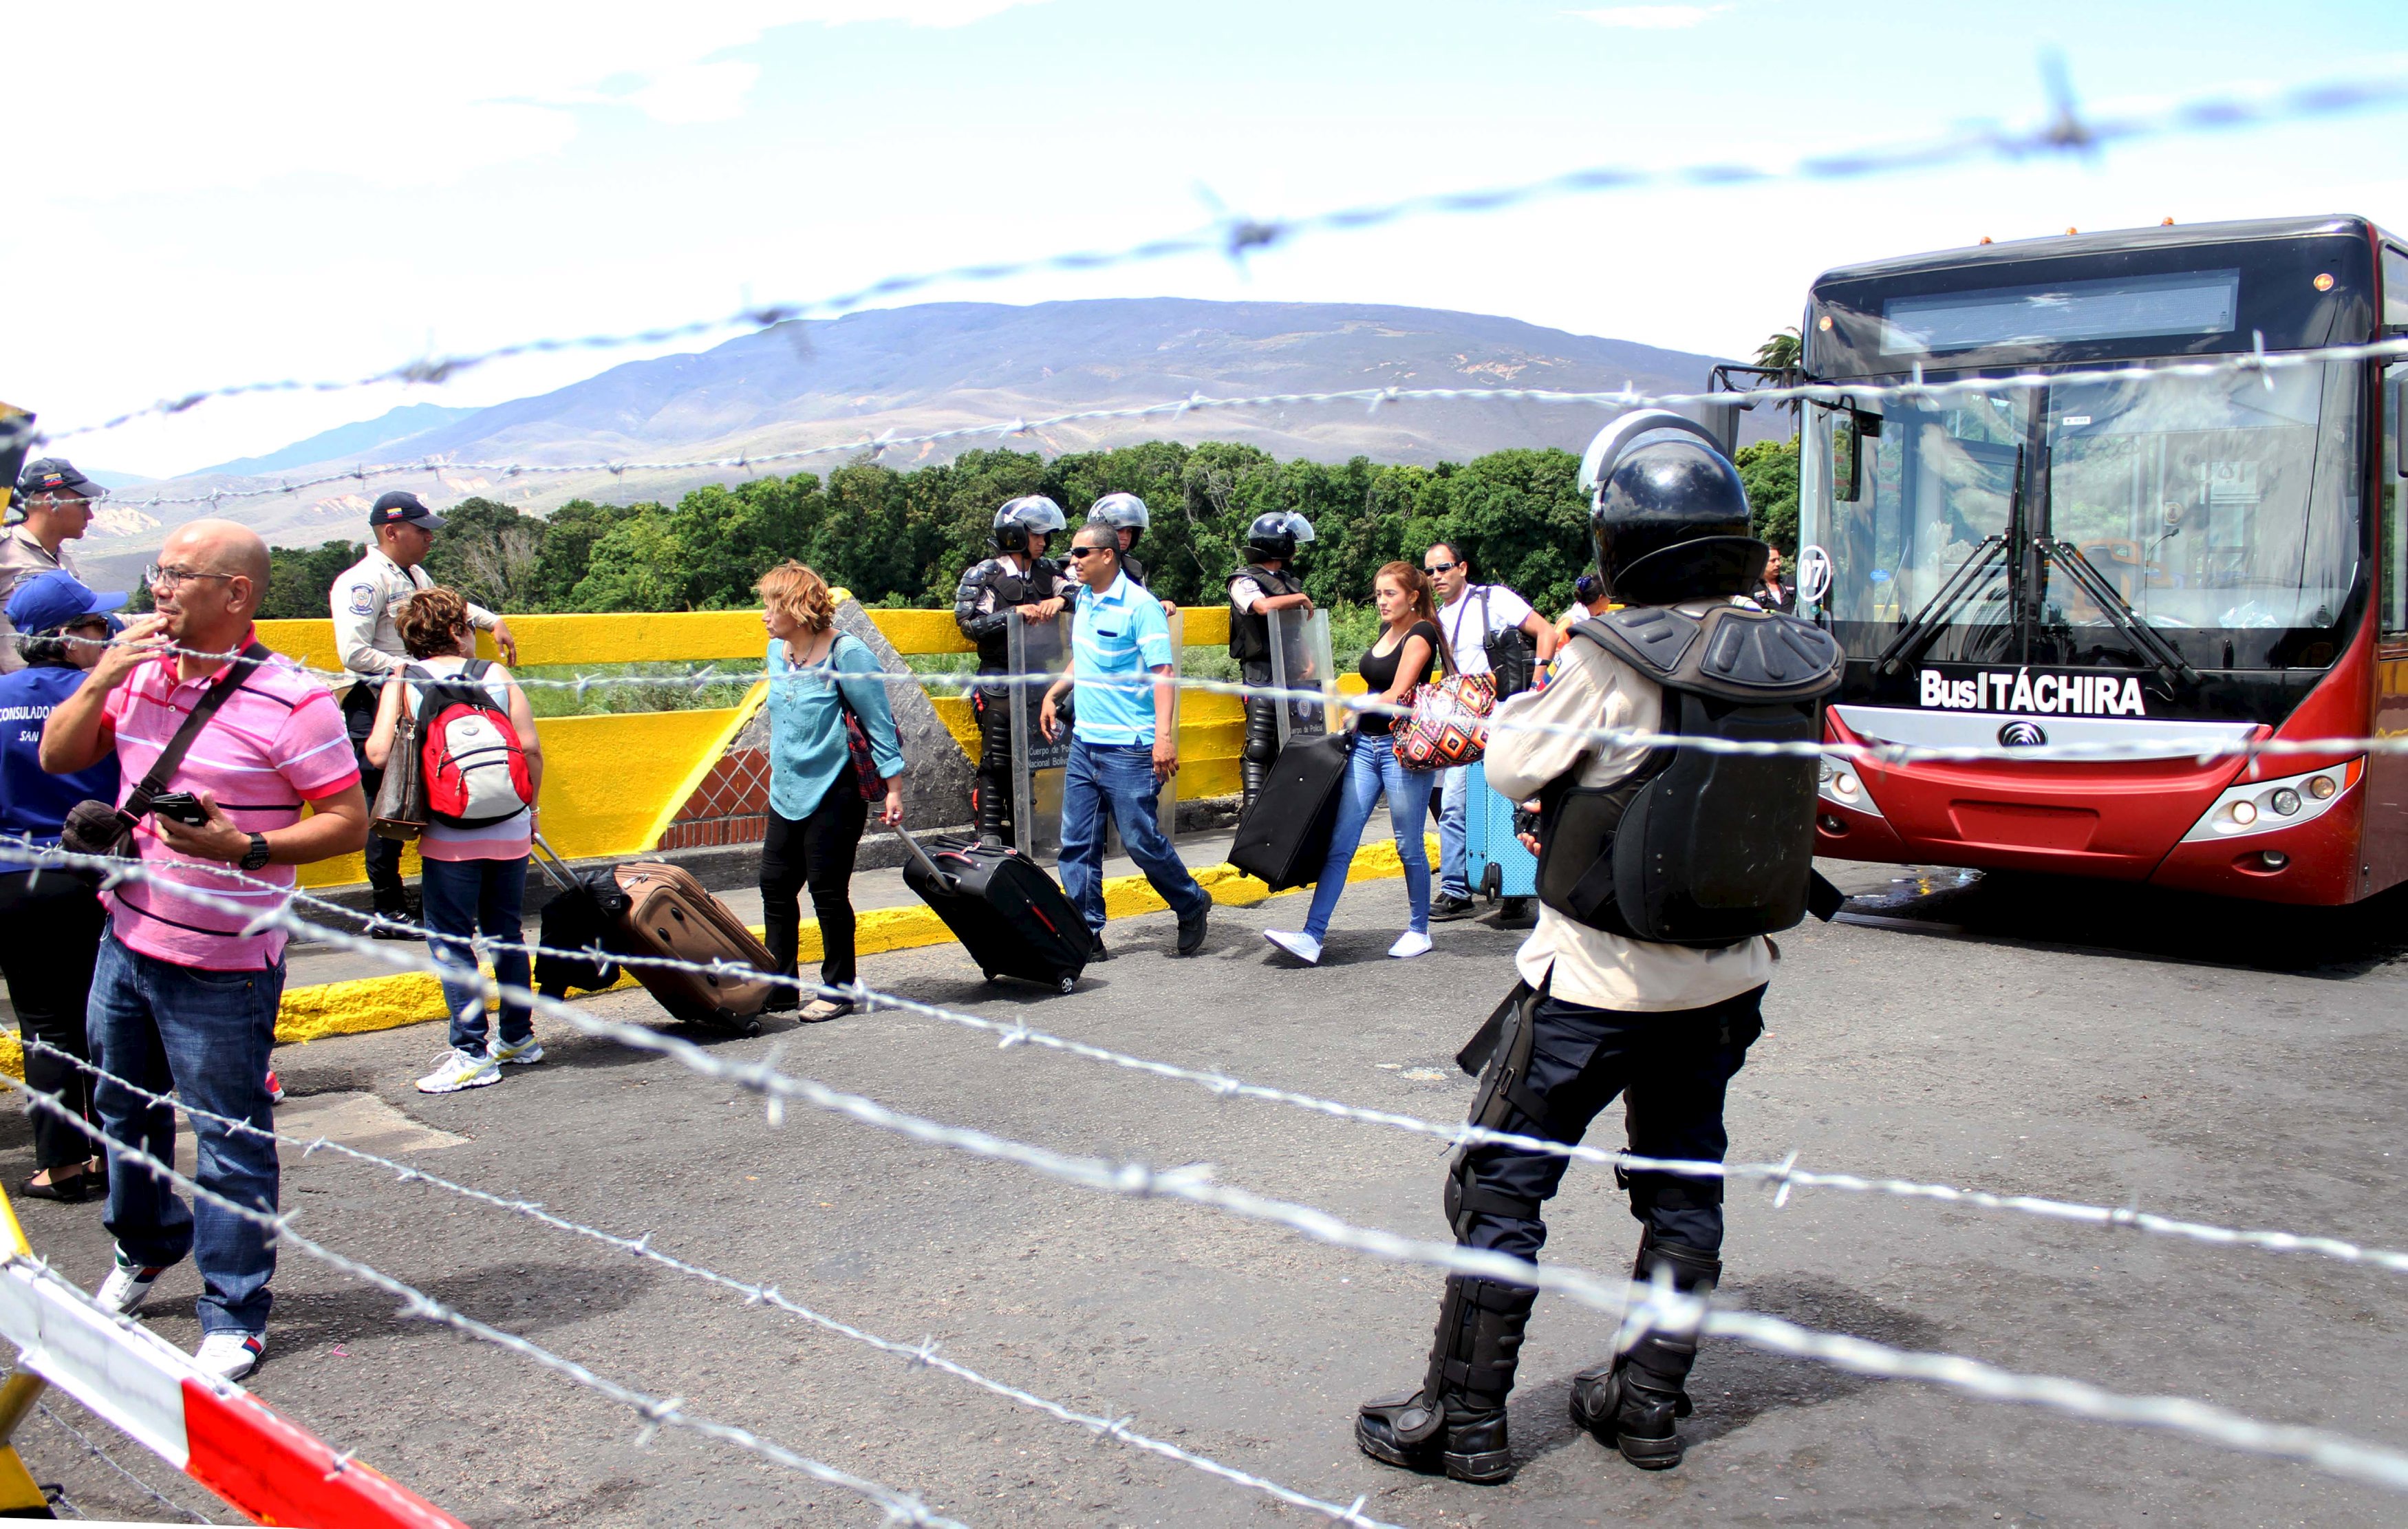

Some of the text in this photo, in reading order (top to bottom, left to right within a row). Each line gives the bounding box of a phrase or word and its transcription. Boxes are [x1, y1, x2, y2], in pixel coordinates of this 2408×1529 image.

[1800, 559, 1825, 588] 07
[1990, 666, 2146, 716] TÁCHIRA
[19, 730, 39, 742] SAN
[1029, 744, 1071, 757] Cuerpo de Pol
[1052, 756, 1068, 766] Boliva
